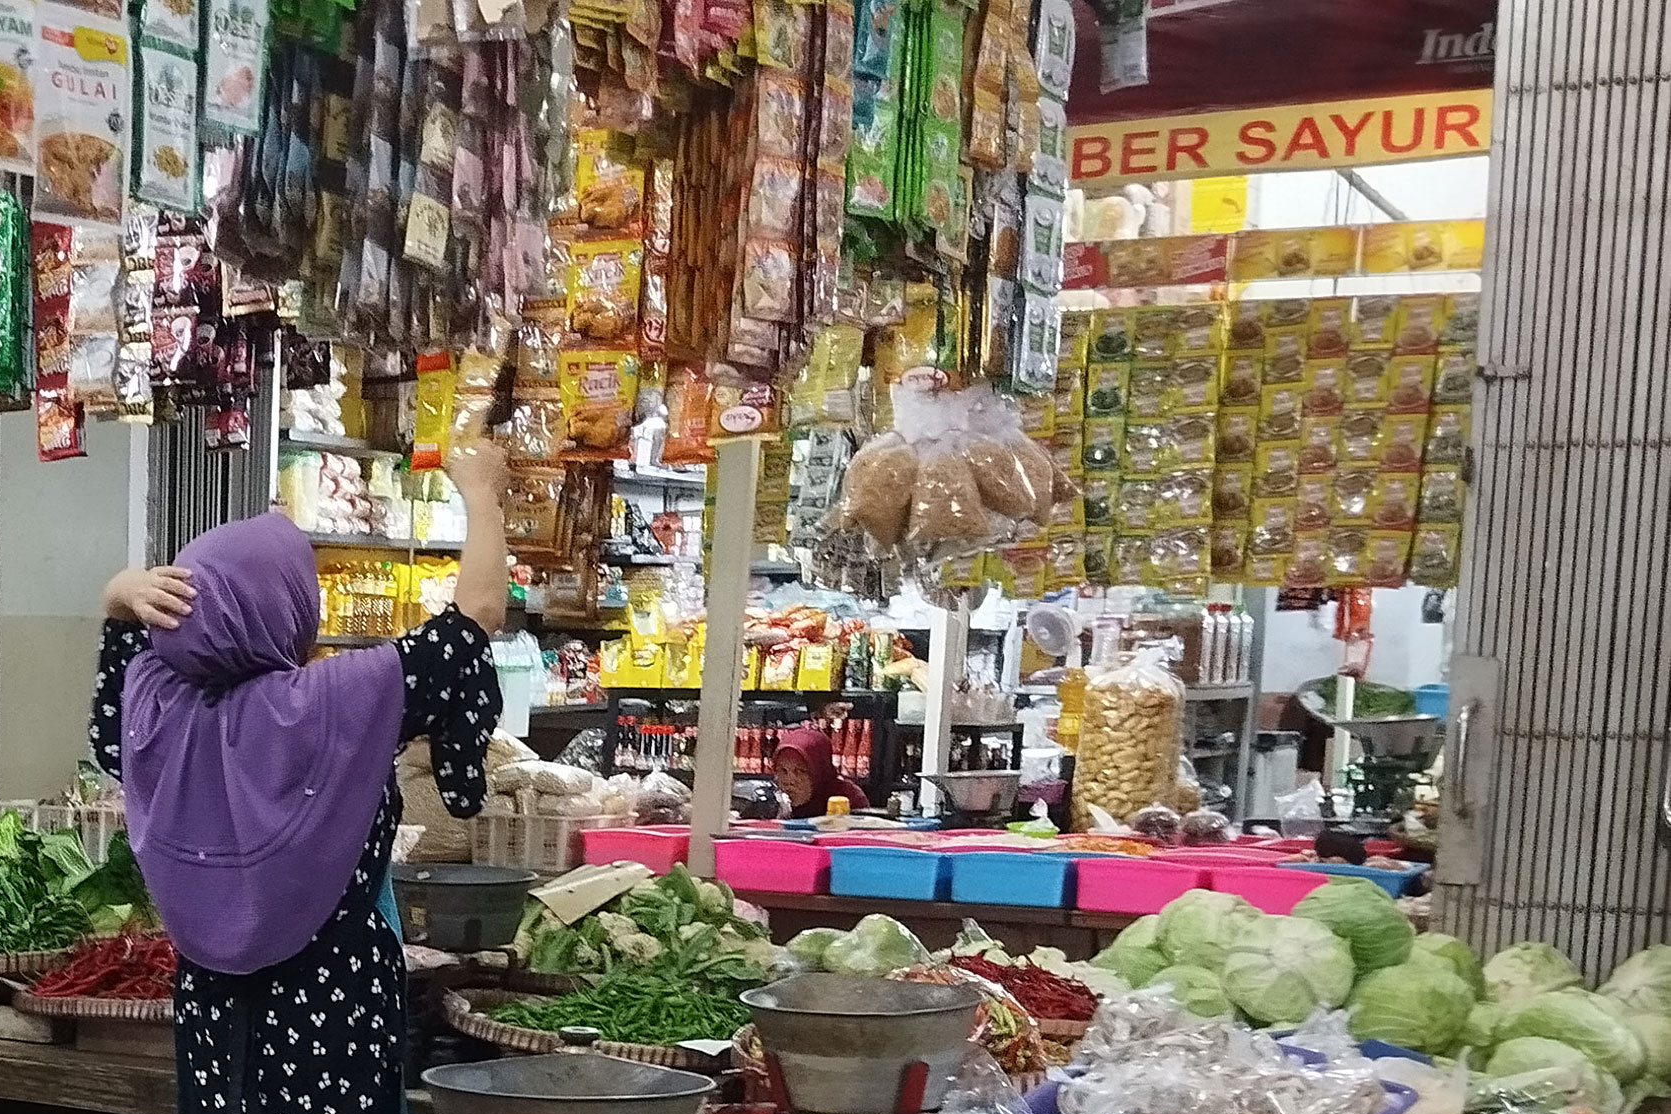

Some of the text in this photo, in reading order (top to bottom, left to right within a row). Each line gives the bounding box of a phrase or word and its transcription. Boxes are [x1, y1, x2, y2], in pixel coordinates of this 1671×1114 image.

[1415, 22, 1495, 65] Ind
[51, 71, 117, 100] GULAI
[1071, 103, 1481, 181] BER SAYUR
